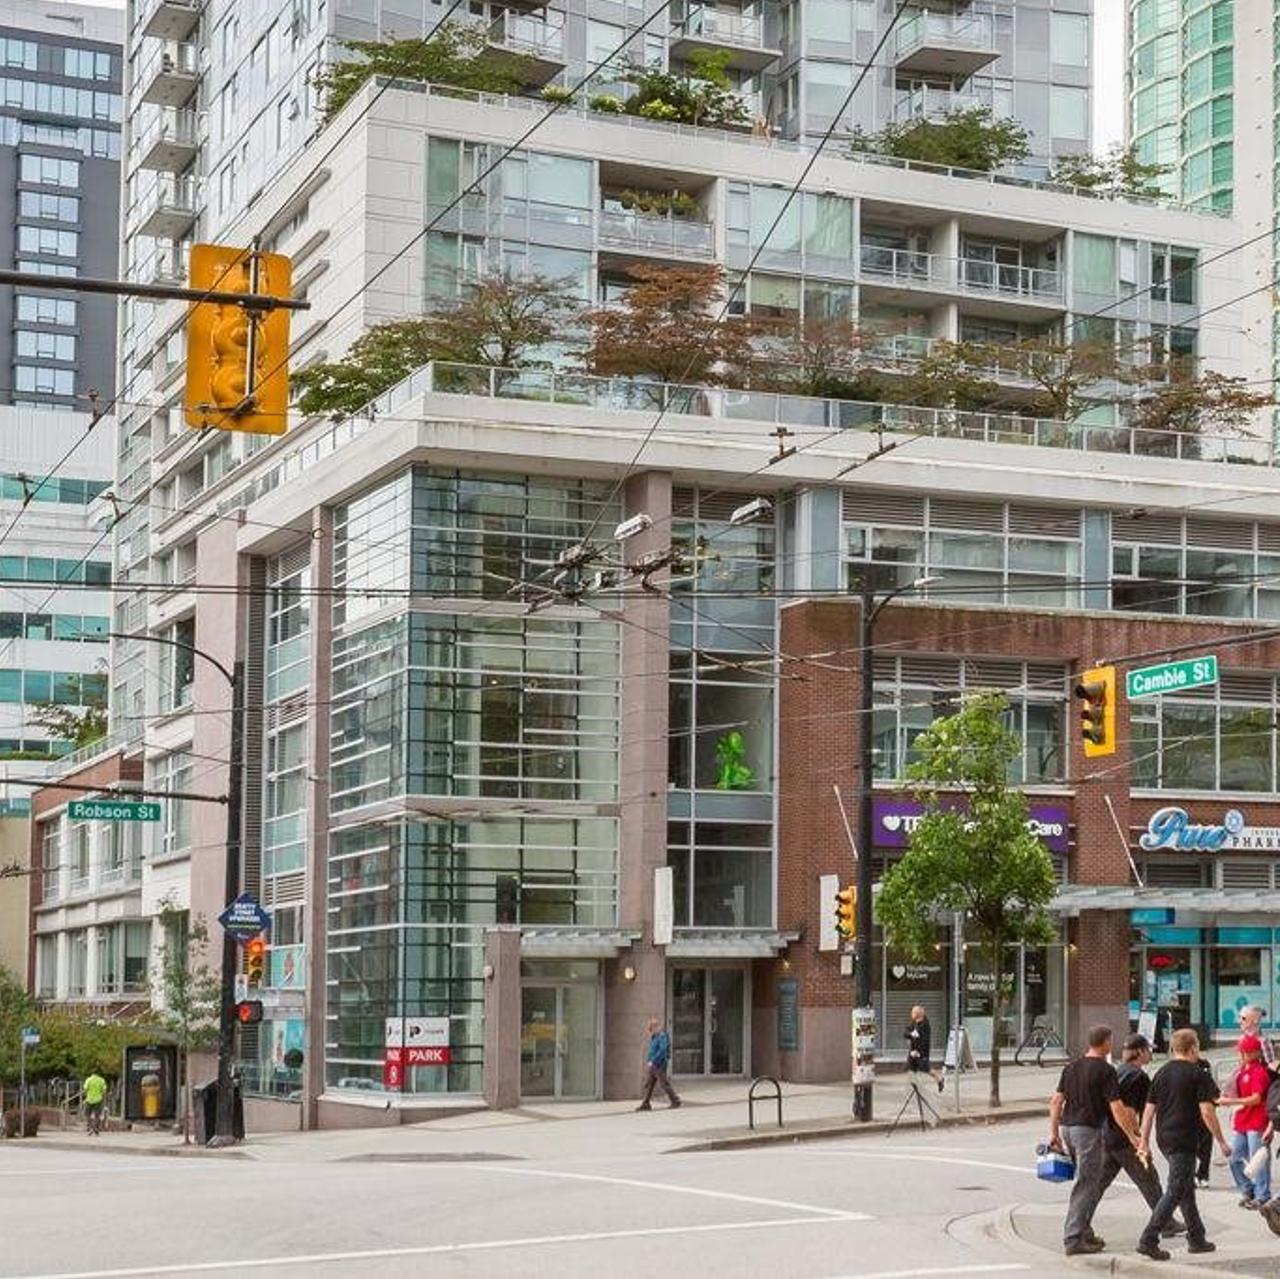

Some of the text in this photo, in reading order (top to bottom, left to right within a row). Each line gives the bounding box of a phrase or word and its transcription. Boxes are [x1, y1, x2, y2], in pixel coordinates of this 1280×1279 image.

[1132, 661, 1211, 693] Cambie St
[74, 803, 154, 819] Robson St
[1139, 807, 1229, 851] Pure
[409, 1049, 443, 1061] PARK
